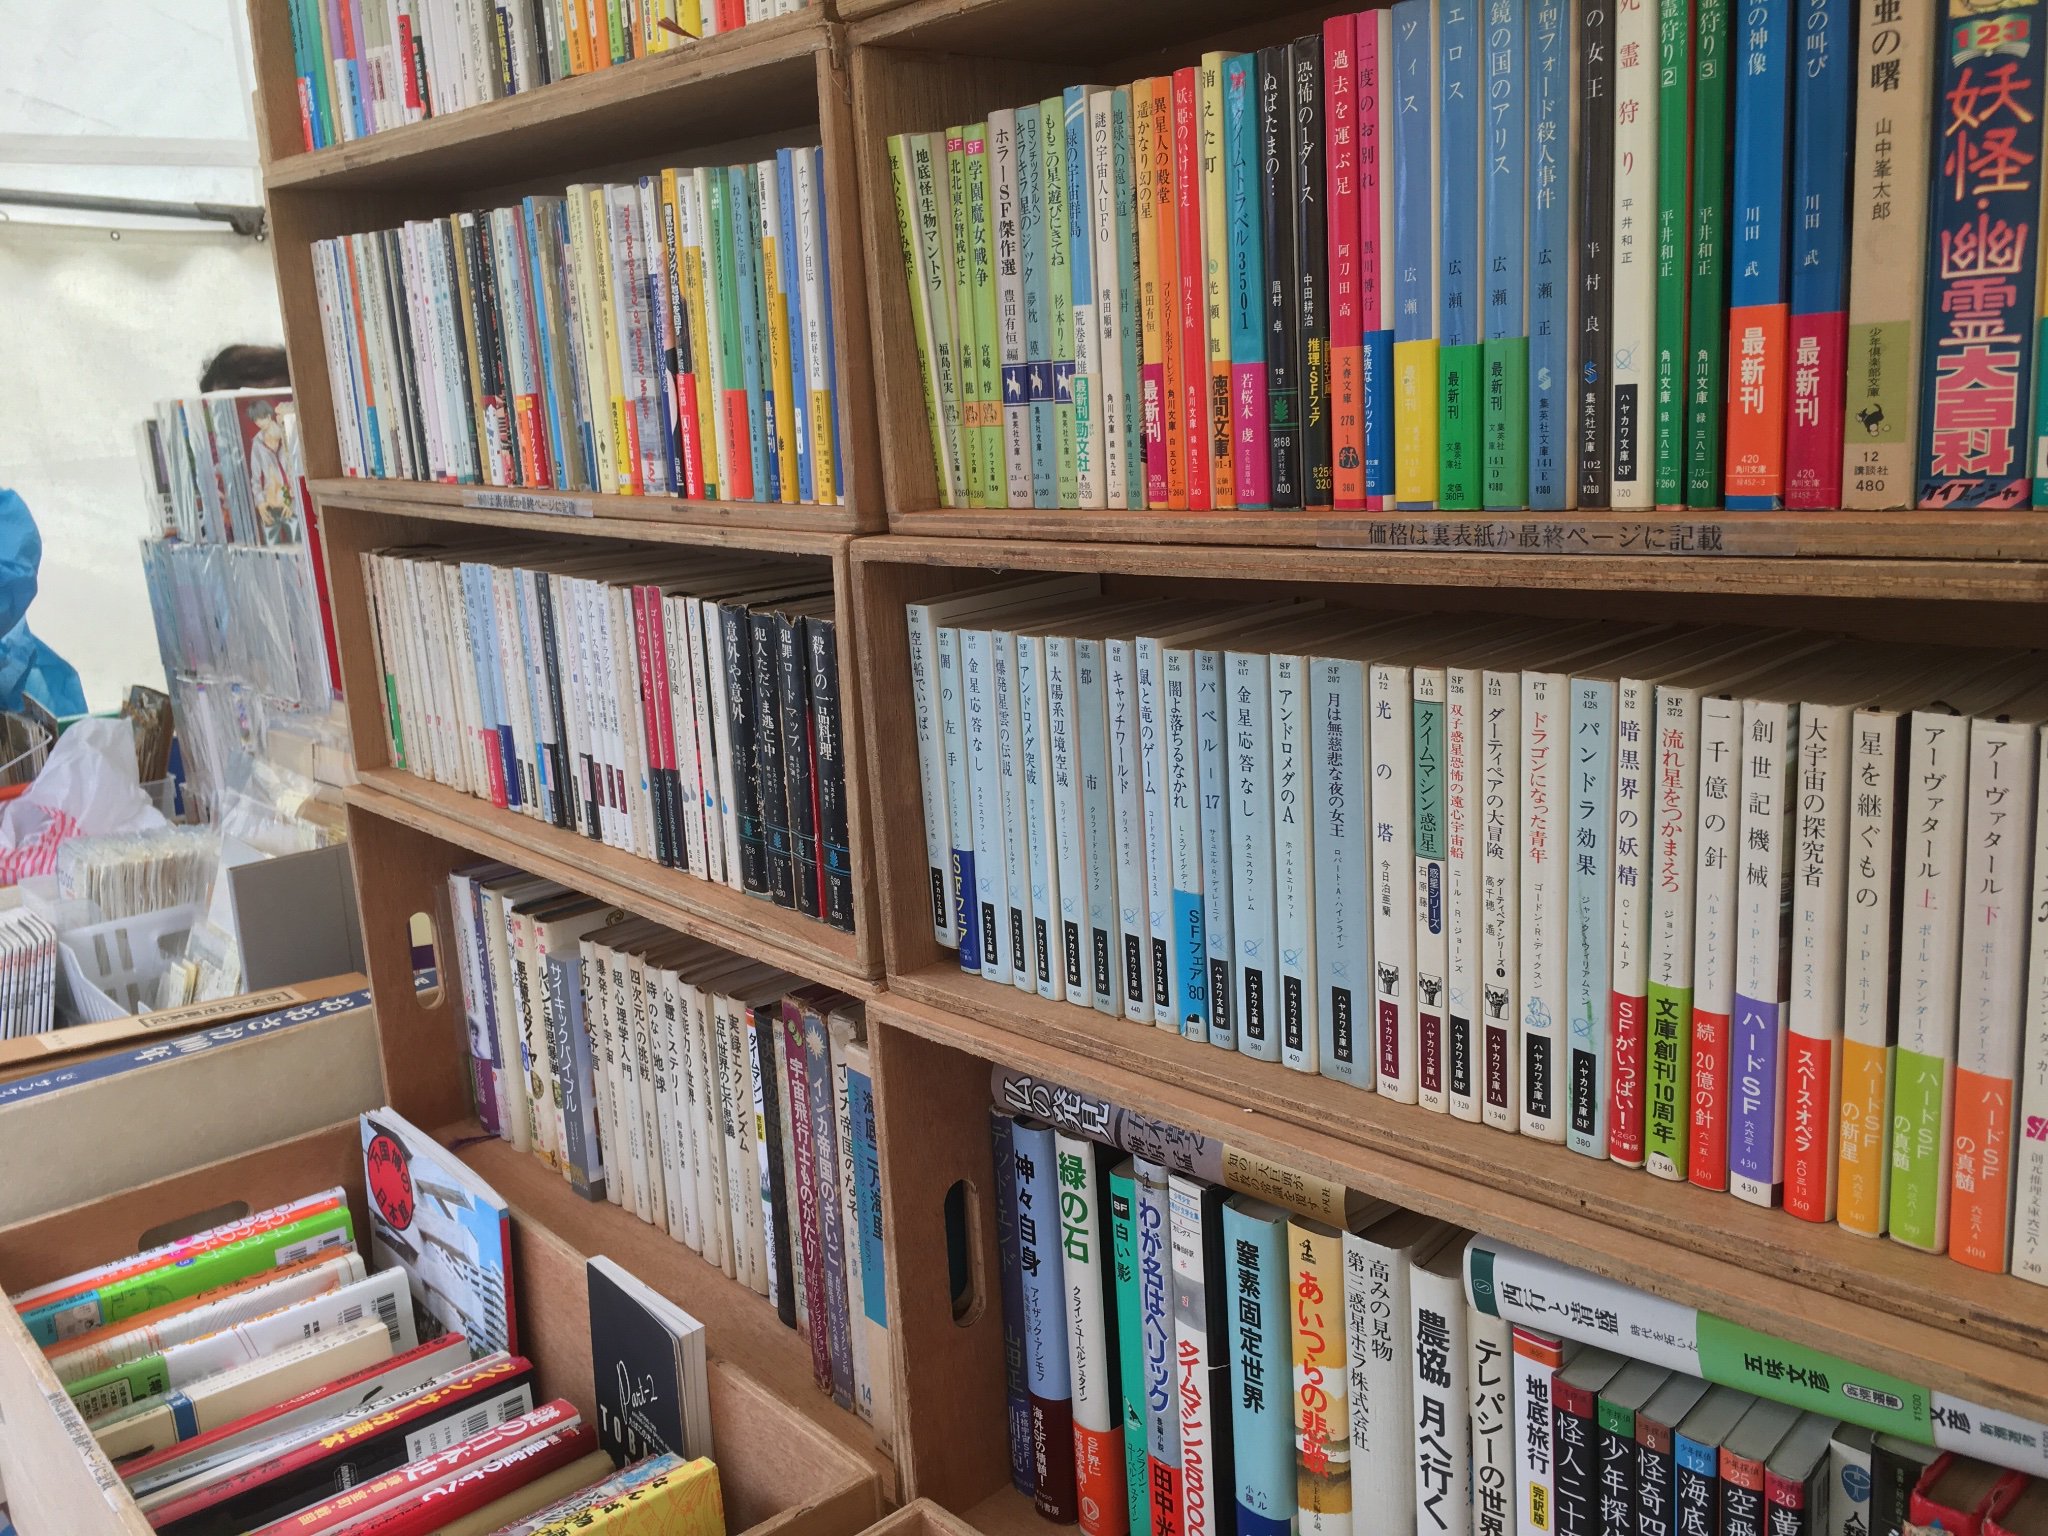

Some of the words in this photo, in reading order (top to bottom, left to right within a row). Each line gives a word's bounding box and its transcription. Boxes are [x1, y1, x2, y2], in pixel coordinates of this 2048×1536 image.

[1402, 20, 1418, 114] ツィス
[1447, 7, 1465, 101] エロス
[1490, 3, 1512, 177] 鏡の国のアリス
[948, 139, 963, 152] SF
[967, 142, 983, 155] SF
[1154, 97, 1171, 205] 異星人の殿堂
[1202, 70, 1215, 174] 消えた町
[1297, 62, 1314, 203] 恐怖の1ダース
[1334, 50, 1351, 196] 過去を運ぶ足
[799, 166, 814, 282] チャップリン自伝
[915, 148, 942, 292] 地底怪生物マントラ
[968, 160, 989, 288] 学園魔女戦争
[996, 128, 1018, 277] ホラーSF傑作選
[1045, 114, 1065, 268] ももこの星へ遊びにきてね
[1094, 112, 1110, 242] 謎の宇宙人UFO
[1621, 199, 1633, 264] 平井和正
[1660, 210, 1673, 277] 平井和正
[1931, 63, 2036, 476] 妖怪・幽霊大百科
[1585, 242, 1600, 332] 半村良
[1143, 380, 1161, 443] 最新刊
[1447, 372, 1459, 419] 最新刊
[1490, 362, 1503, 411] 最新刊
[1660, 350, 1671, 403] 角川文庫
[1696, 350, 1708, 404] 角川文庫
[1741, 327, 1766, 414] 最新刊
[1795, 337, 1821, 427] 最新刊
[1583, 460, 1601, 469] 102
[1585, 392, 1596, 453] 集英社文庫
[1741, 454, 1759, 463] 420
[1863, 452, 1879, 462] 12
[1276, 484, 1291, 494] 400
[1616, 489, 1631, 498] 320
[1797, 470, 1815, 479] 420
[1856, 480, 1885, 491] 480
[1369, 522, 1723, 552] 価格は裏表紙か最終ページに記載
[726, 620, 746, 724] 意外や意外
[968, 657, 983, 772] 金星応答なし
[1327, 666, 1339, 674] SF
[1327, 675, 1341, 684] 207
[1582, 701, 1598, 709] 428
[1583, 690, 1597, 699] SF
[1666, 708, 1683, 717] 372
[1667, 697, 1683, 706] SF
[1019, 665, 1037, 786] アンドロメダ突破
[1050, 665, 1069, 788] 太陽系辺境空域
[1112, 670, 1129, 795] キャッチワールド
[1138, 668, 1156, 795] 鼠と竜のゲーム
[1168, 680, 1188, 809] 闇よ落ちるなかれ
[1237, 685, 1254, 817] 金星応答なし
[1279, 689, 1295, 824] アンドロメダのA
[1326, 692, 1345, 838] 月は無慈悲な夜の女王
[1419, 710, 1436, 853] タイムマシン惑星
[1450, 704, 1464, 860] 双子惑星恐怖の遠心宇宙船
[1486, 708, 1505, 860] ダーティペアの大冒険
[1529, 712, 1548, 864] ドラゴンになった青年
[1576, 722, 1600, 876] パンドラ効果
[1618, 720, 1641, 887] 暗黒界の妖精
[1661, 728, 1685, 893] 流れ星をつかまえろ
[1704, 714, 1731, 870] 一千億の針
[1747, 718, 1773, 888] 創世記機械
[1802, 718, 1828, 888] 大宇宙の探究者
[1856, 731, 1883, 907] 星を継ぐもの
[612, 969, 633, 1082] 超心理学入門
[630, 969, 650, 1082] 四次元への挑戦
[645, 980, 666, 1093] 時のない地球
[1653, 998, 1679, 1145] 文庫創刊10周年
[1743, 1012, 1765, 1115] ハードSF
[1530, 1122, 1546, 1131] 480
[1576, 1137, 1590, 1147] 380
[1795, 1050, 1815, 1152] スペース・オペラ
[1917, 1071, 1938, 1158] ハードSF
[1981, 1091, 2004, 1180] ハードSF
[790, 1058, 815, 1262] 宇宙飛行士ものがたり
[1058, 1151, 1090, 1264] 緑の石
[1113, 1202, 1128, 1212] SF
[1741, 1183, 1758, 1195] 430
[1015, 1151, 1041, 1278] 神々自身
[1236, 1239, 1265, 1414] 窒素固定世界
[1347, 1249, 1371, 1452] 第三惑星ホラ株式会社
[1368, 1259, 1394, 1362] 高みの見物
[1501, 1281, 1619, 1336] 西行と清盛
[861, 1384, 871, 1405] 14
[1297, 1271, 1330, 1478] あいつらの悲歌
[1525, 1374, 1550, 1475] 地底旅行
[1744, 1353, 1831, 1394] 五味文彦
[1646, 1434, 1656, 1449] 8
[1686, 1456, 1705, 1474] 12
[1730, 1472, 1750, 1487] 25
[1776, 1492, 1796, 1508] 26
